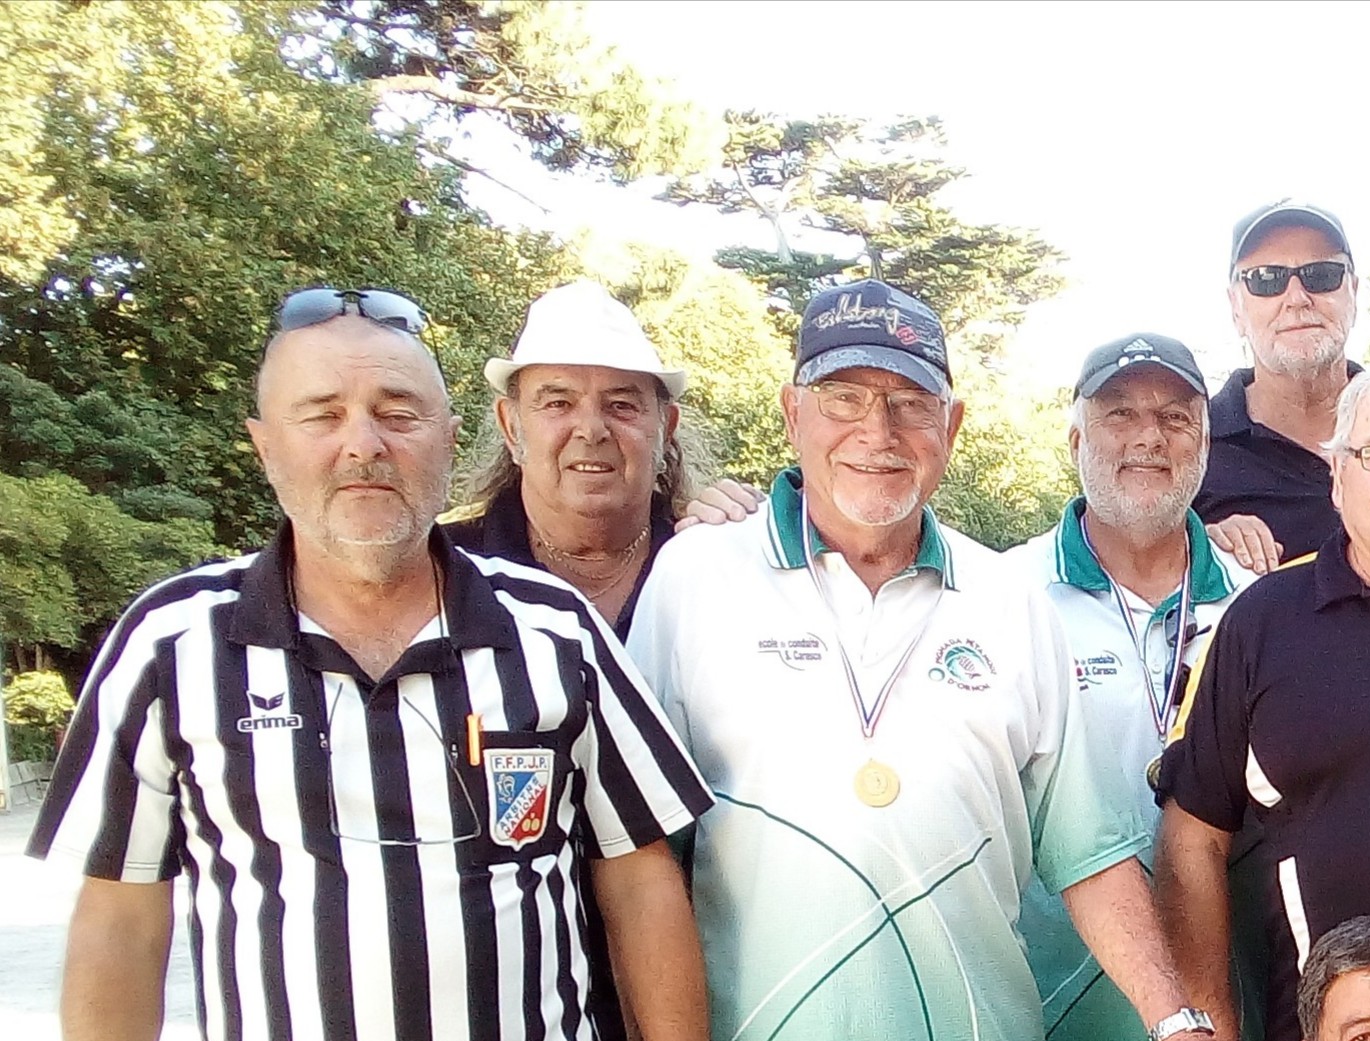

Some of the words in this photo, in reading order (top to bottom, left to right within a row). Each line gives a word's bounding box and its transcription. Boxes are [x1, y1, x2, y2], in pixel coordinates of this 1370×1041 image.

[239, 714, 300, 731] erima
[494, 756, 548, 770] F.F.P.J.P.
[503, 784, 546, 836] NATIONAL
